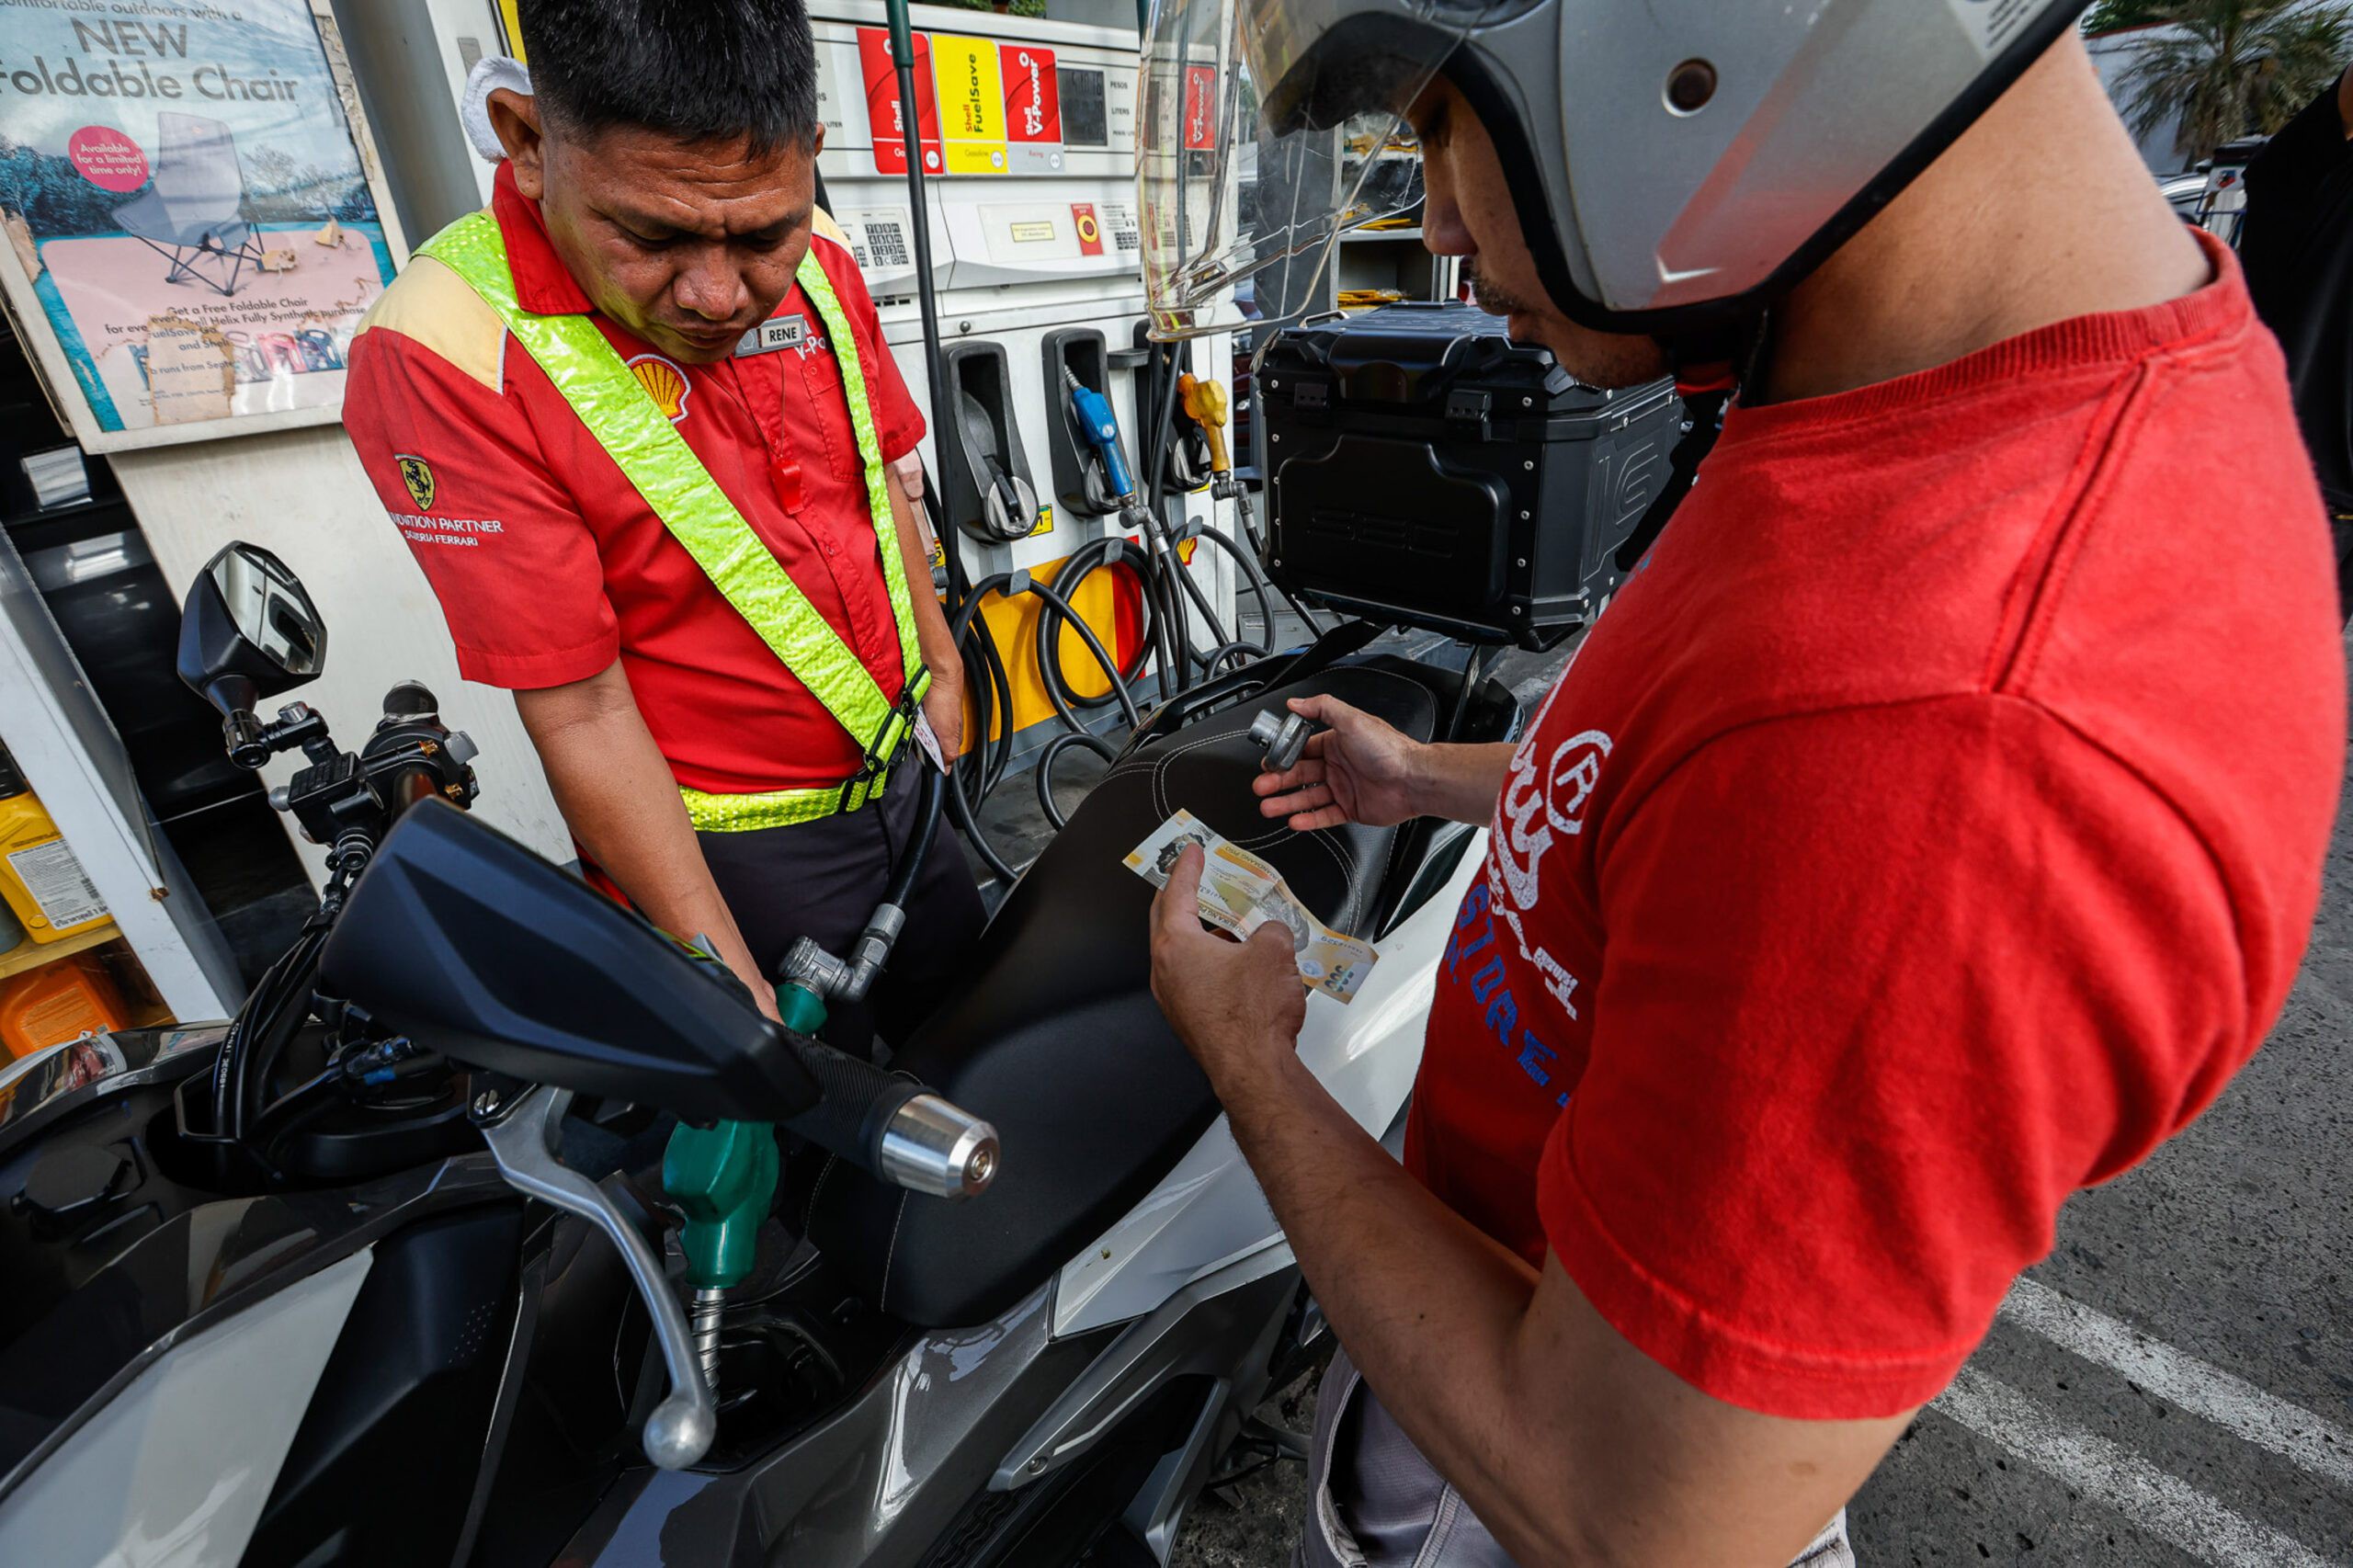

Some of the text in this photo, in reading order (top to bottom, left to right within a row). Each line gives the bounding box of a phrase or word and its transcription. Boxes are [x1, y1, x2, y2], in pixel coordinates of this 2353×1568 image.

[110, 2, 188, 17] outdoors
[71, 17, 188, 59] NEW
[192, 62, 300, 101] Chair
[1109, 80, 1129, 90] PESOS
[969, 53, 984, 133] FuelSave
[1029, 58, 1043, 135] V-Power
[962, 104, 973, 132] Shell
[1110, 107, 1131, 116] LITERS
[1024, 107, 1034, 136] Shell
[81, 142, 131, 153] Available
[76, 153, 93, 164] for
[104, 153, 142, 164] limited
[88, 164, 142, 177] time only!
[202, 303, 227, 313] Free
[230, 298, 277, 312] Foldable
[279, 297, 309, 307] Chair
[210, 312, 240, 325] Helix
[243, 311, 268, 324] Fully
[105, 323, 124, 335] for
[768, 326, 798, 343] RENE
[178, 339, 200, 351] and
[438, 517, 505, 533] PARTNER
[435, 534, 479, 547] FERRARI
